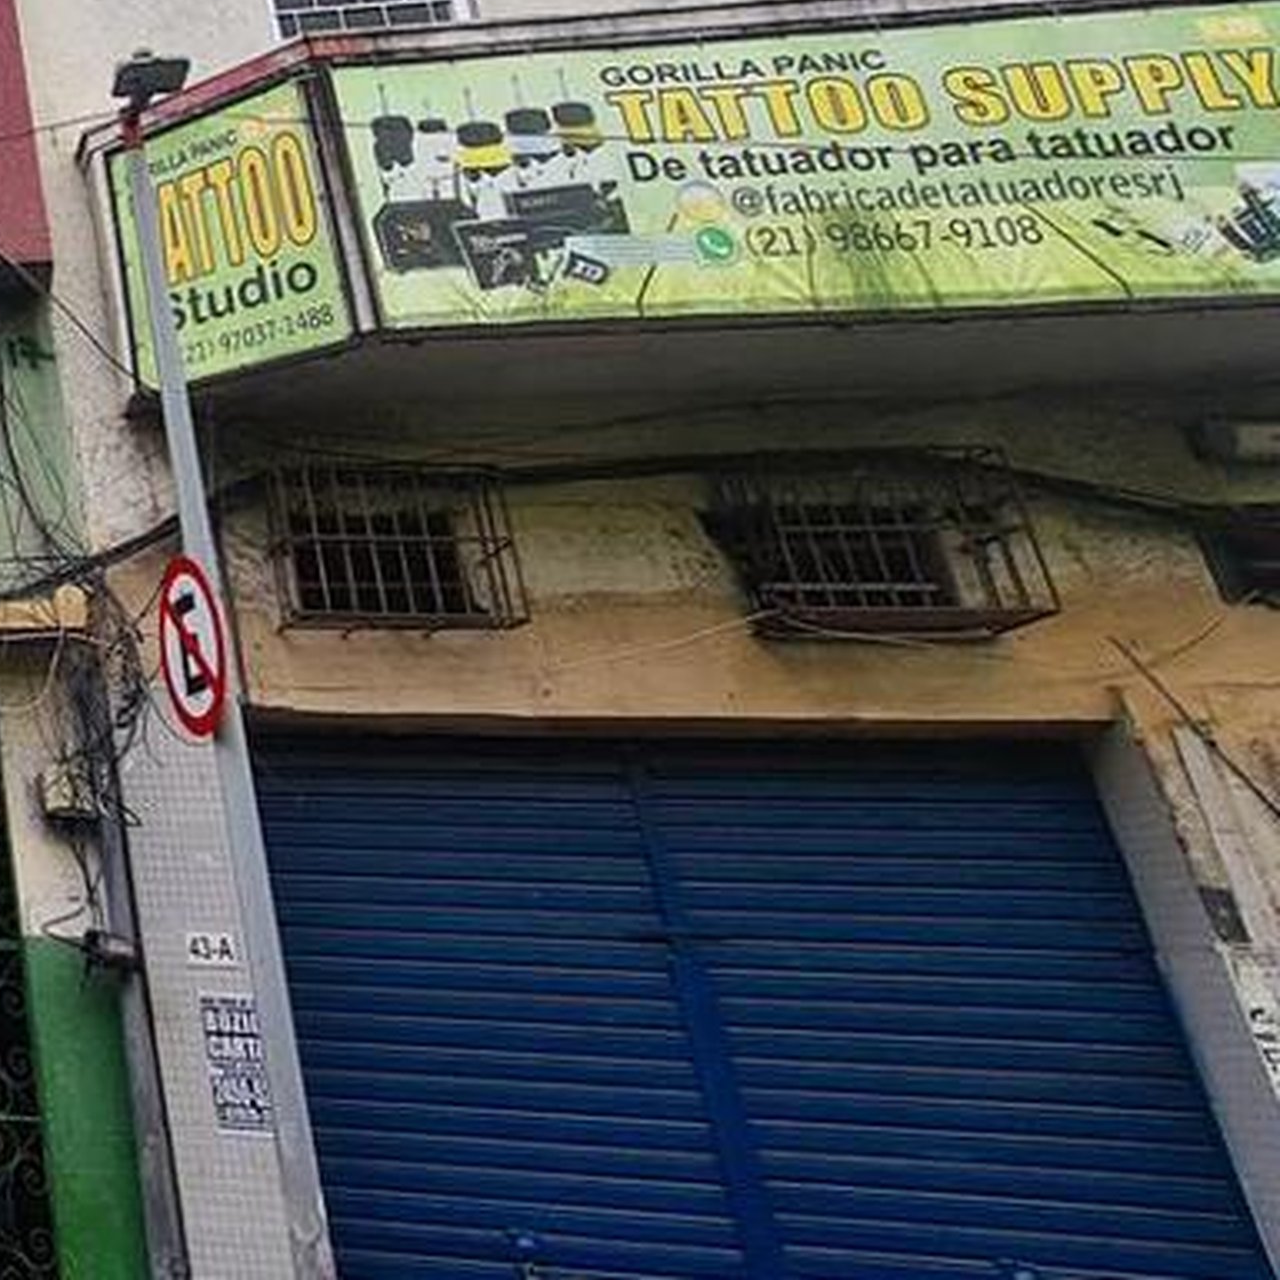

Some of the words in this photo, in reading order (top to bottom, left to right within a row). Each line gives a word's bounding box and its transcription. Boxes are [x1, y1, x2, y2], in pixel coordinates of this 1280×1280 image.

[598, 59, 766, 88] GORILLA
[771, 48, 888, 76] PANIC
[604, 72, 931, 146] TATTOO
[941, 47, 1280, 129] SUPPLY
[626, 151, 688, 182] De
[698, 140, 893, 181] tatuador
[910, 136, 1016, 174] para
[1027, 121, 1235, 161] tatuador
[156, 129, 317, 284] ATTOO
[744, 224, 817, 257] (21)
[824, 215, 1045, 253] 98667-9108
[189, 935, 234, 961] 43-A
